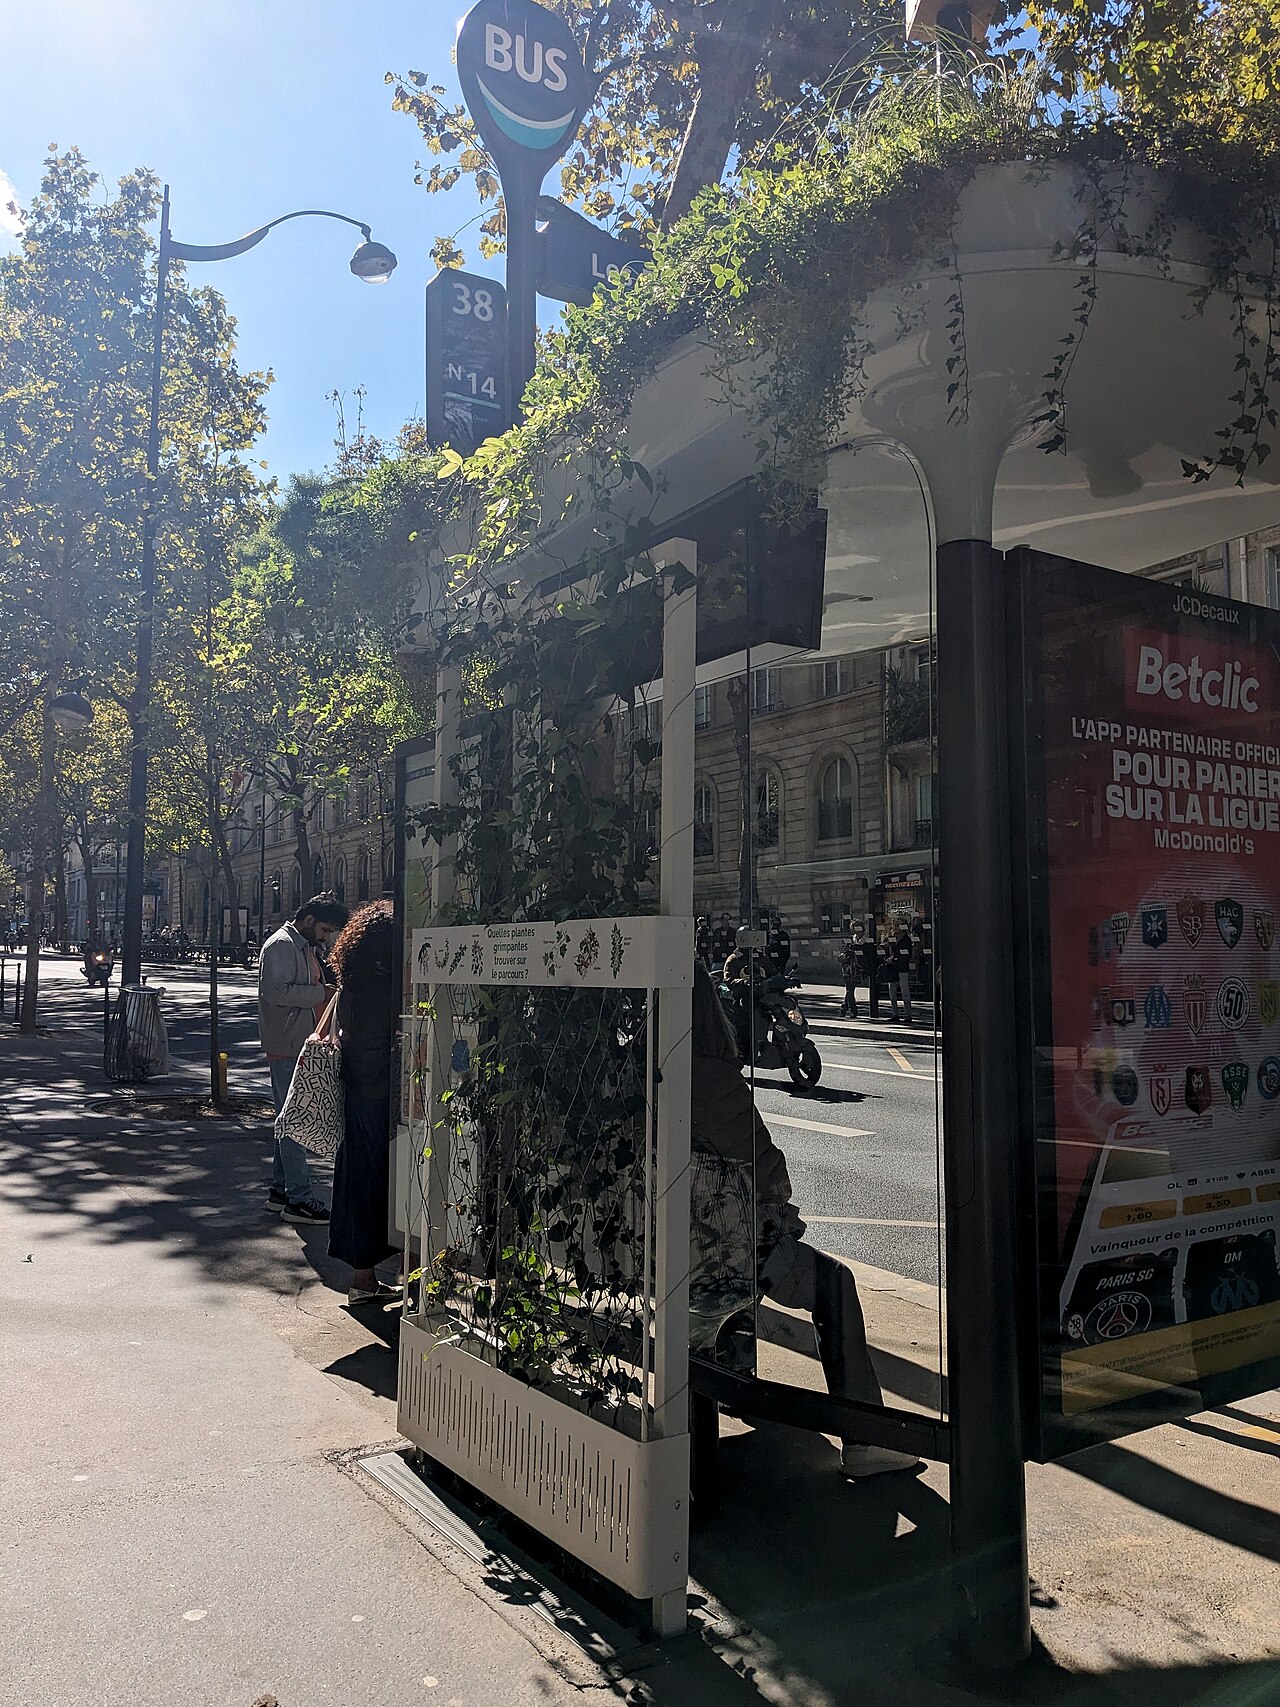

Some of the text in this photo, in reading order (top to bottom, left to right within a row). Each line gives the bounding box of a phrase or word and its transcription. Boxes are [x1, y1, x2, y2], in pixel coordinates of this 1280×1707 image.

[485, 23, 568, 92] BUS
[451, 281, 495, 322] 38
[1172, 594, 1240, 625] JCDecaux
[1136, 645, 1261, 713] Betclic
[1071, 716, 1122, 743] L'APP
[1126, 725, 1231, 759] PARTENAIRE
[1113, 749, 1280, 800] POUR PARIER
[1106, 784, 1280, 833] SUR LA LIGUE
[1154, 828, 1255, 856] McDonald's
[1219, 905, 1240, 918] HAC
[487, 927, 535, 940] Quelles plantes
[1112, 917, 1128, 931] SCO
[493, 941, 528, 954] grimpantes
[494, 956, 527, 966] trouver sur
[491, 969, 498, 979] le
[498, 970, 524, 981] parcours
[1112, 1001, 1134, 1022] OL
[1223, 986, 1244, 1020] 50
[1224, 1067, 1248, 1081] ASSE
[1167, 1182, 1182, 1190] OL
[1251, 1167, 1276, 1178] ASSE
[1206, 1199, 1231, 1210] 3,50
[1090, 1214, 1274, 1254] Vainqueur de la compétition
[1223, 1250, 1243, 1264] OM
[1096, 1268, 1155, 1291] PARIS SG
[1098, 1293, 1142, 1312] PARIS
